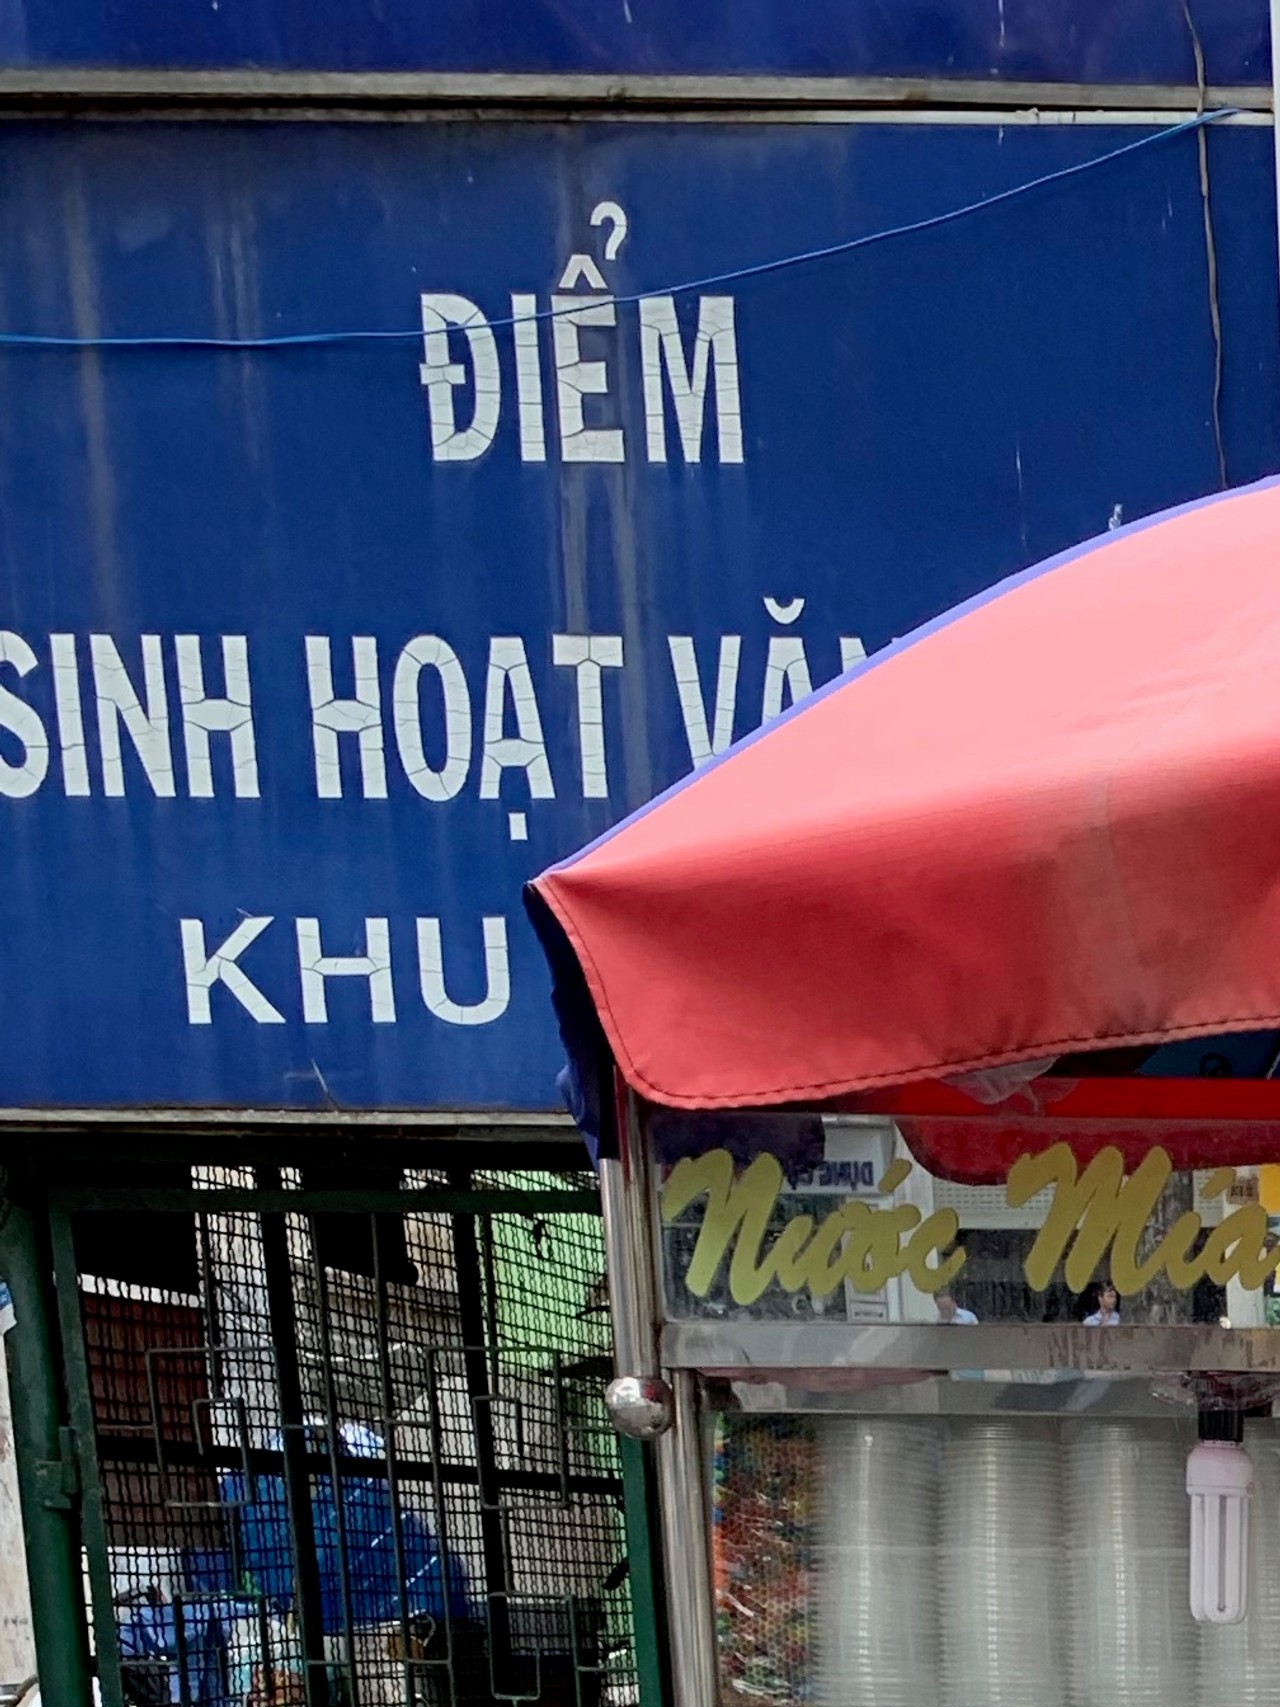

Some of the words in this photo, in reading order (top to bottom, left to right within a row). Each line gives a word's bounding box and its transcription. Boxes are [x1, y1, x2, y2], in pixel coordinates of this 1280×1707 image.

[419, 201, 745, 465] ĐIỂM
[0, 630, 262, 800] SINH
[306, 633, 624, 841] HOẠT
[667, 597, 905, 768] VĂ
[180, 914, 510, 1026] KHU
[662, 1148, 967, 1307] Nước
